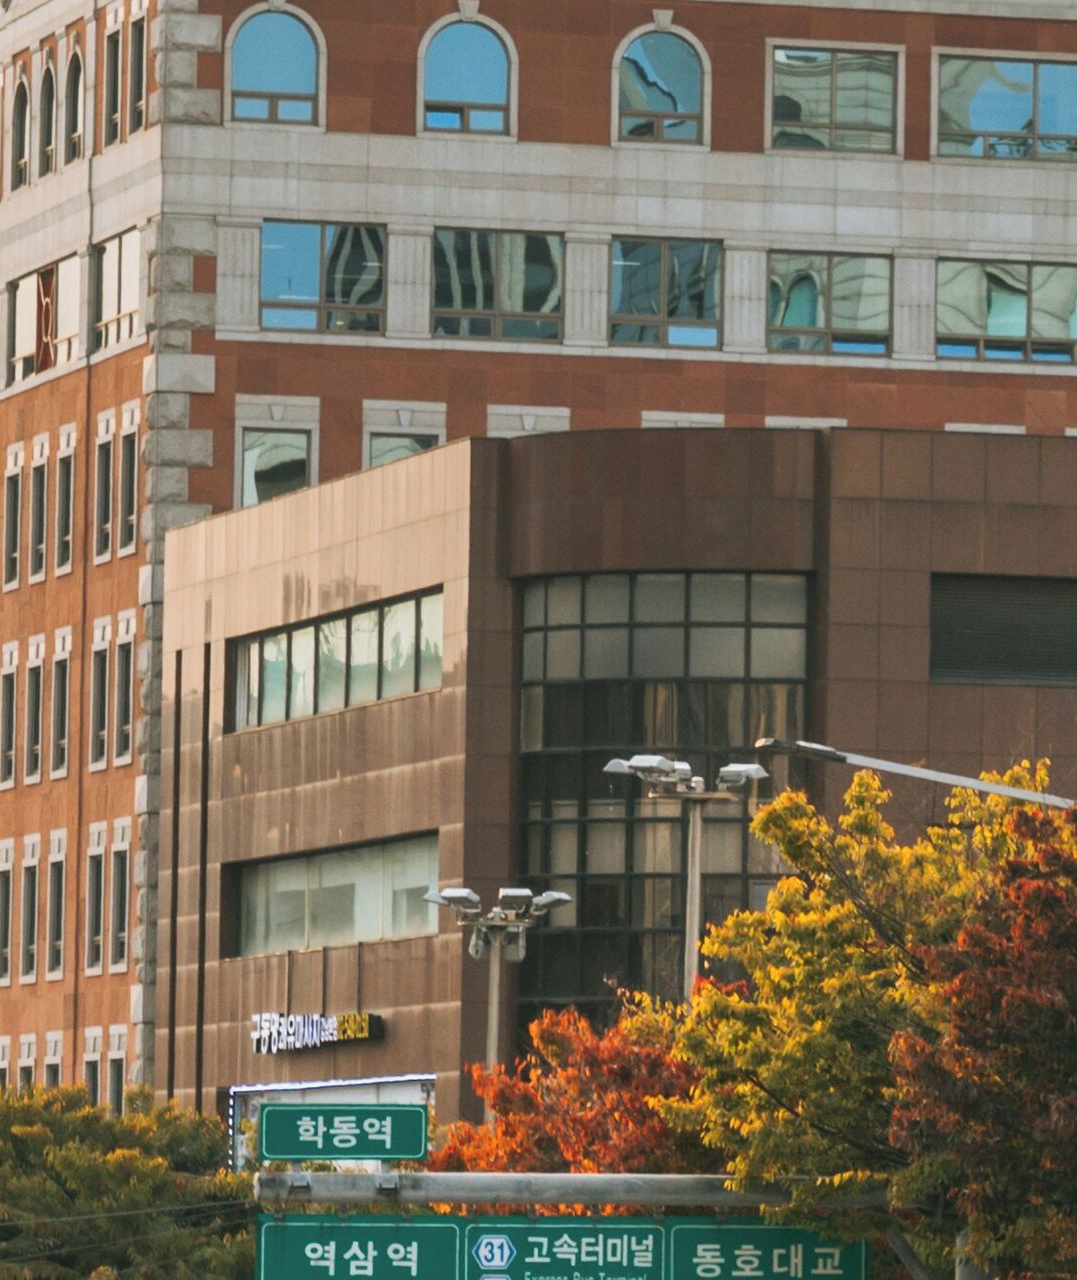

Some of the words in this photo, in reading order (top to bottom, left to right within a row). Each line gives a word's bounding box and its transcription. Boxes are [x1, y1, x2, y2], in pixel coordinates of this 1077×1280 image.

[296, 1115, 393, 1149] 학동역
[304, 1240, 419, 1277] 역삼역
[481, 1241, 507, 1263] 31
[524, 1233, 654, 1268] 고속터미널
[692, 1243, 843, 1279] 동호대교
